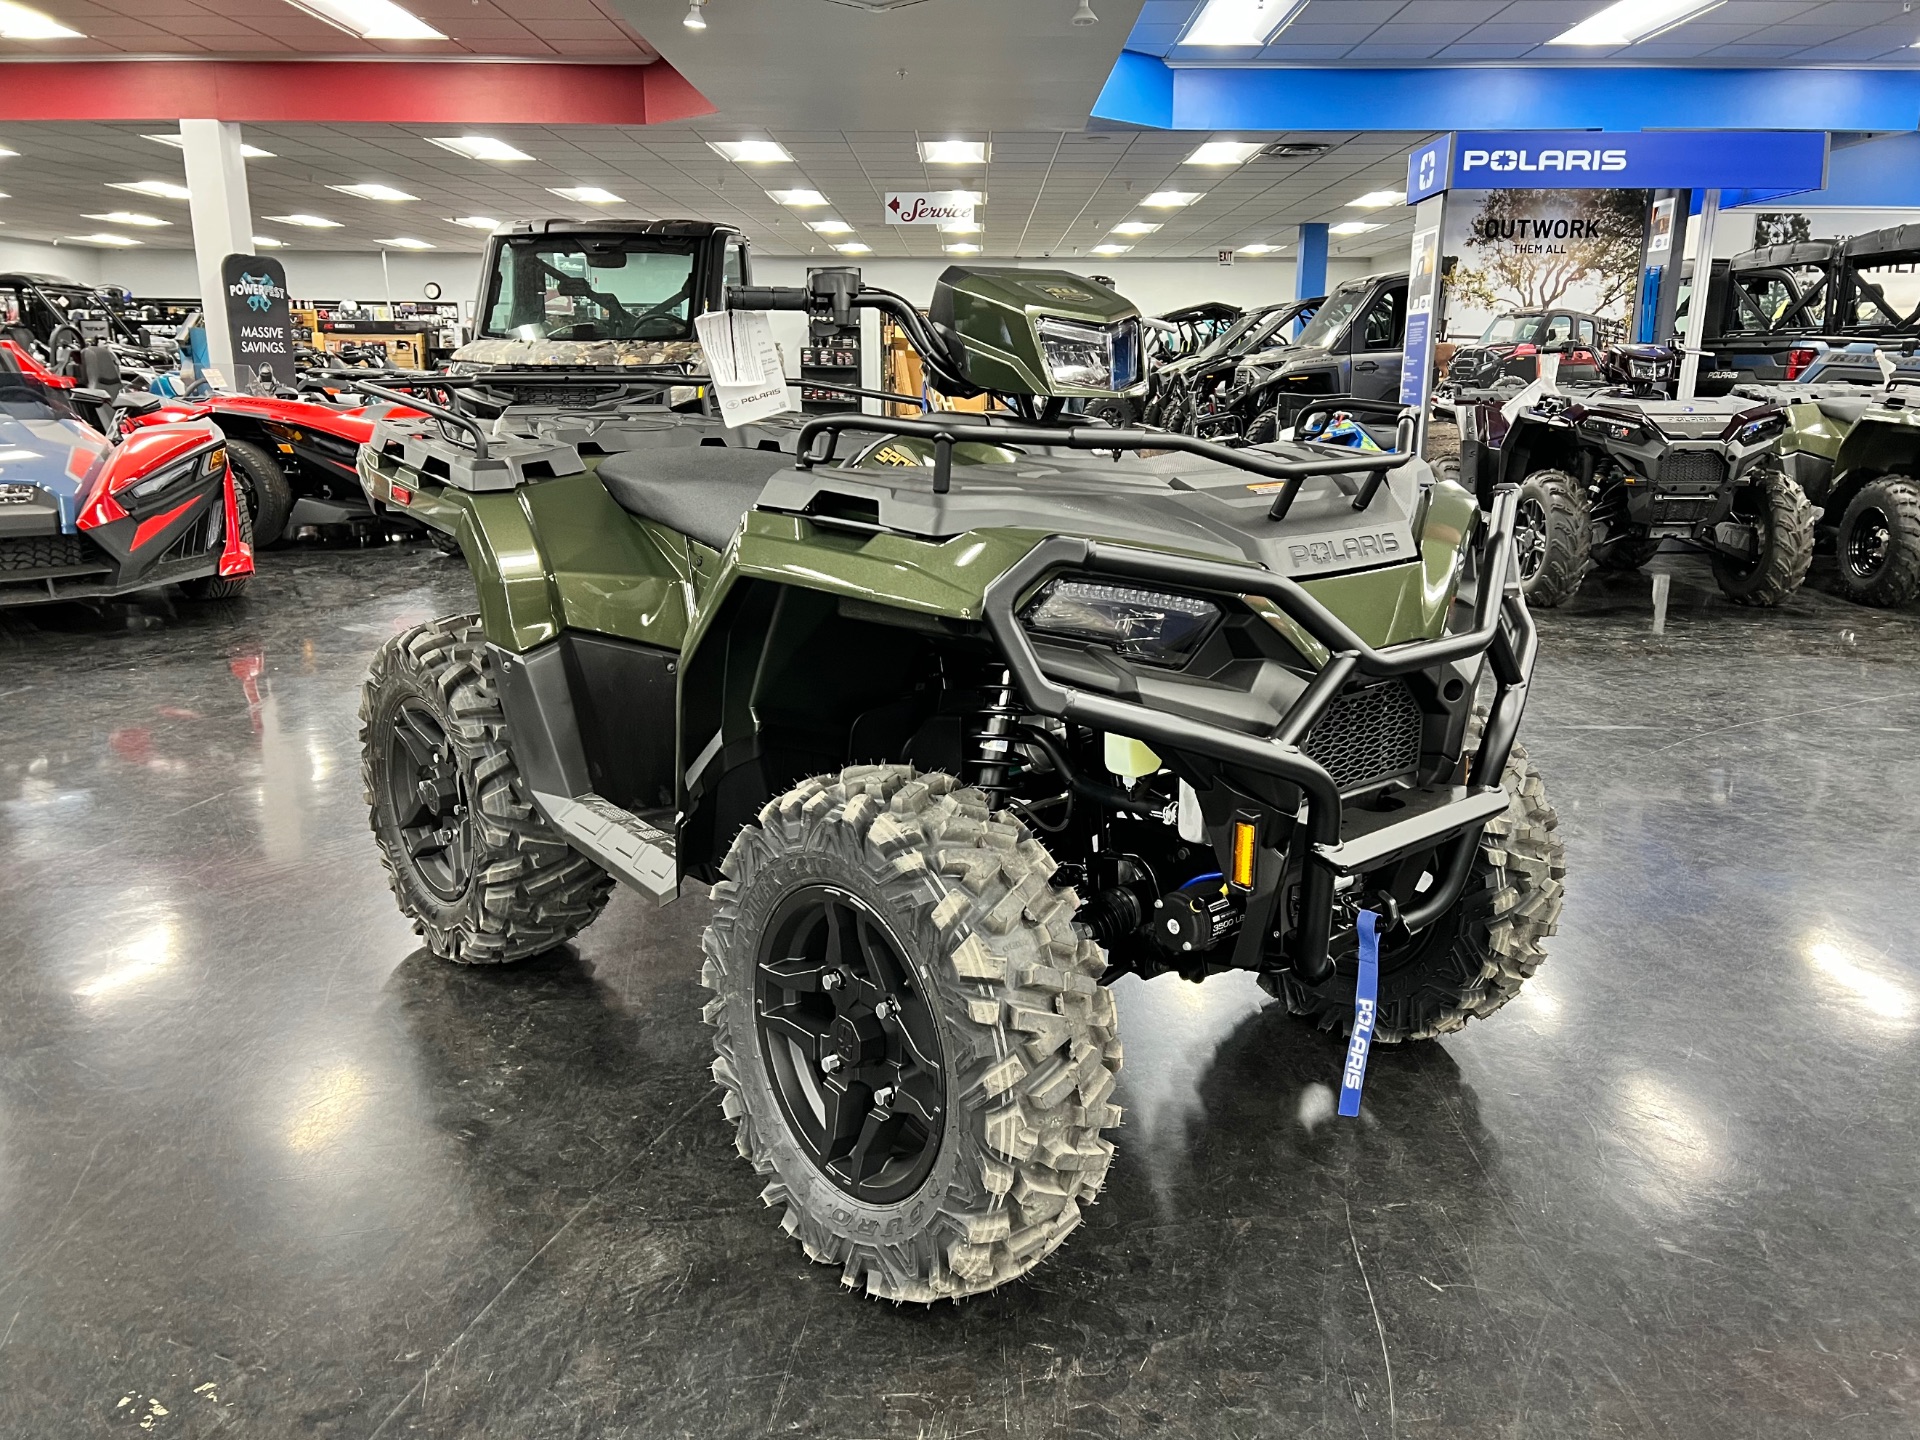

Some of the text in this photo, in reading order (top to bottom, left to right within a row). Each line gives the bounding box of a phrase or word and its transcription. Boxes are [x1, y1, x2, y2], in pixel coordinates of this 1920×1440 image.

[1463, 149, 1628, 171] POLARIS
[901, 197, 973, 222] Service
[1484, 219, 1600, 239] OUTWORK
[1219, 251, 1233, 261] EXIT
[1513, 244, 1567, 254] THEM ALL
[229, 283, 285, 299] POWERFEST
[240, 326, 284, 339] MASSIVE
[240, 341, 287, 354] SAVINGS.
[1707, 371, 1739, 379] POLARIS
[741, 388, 781, 405] POLARIS
[1288, 532, 1400, 568] POLARIS
[1212, 918, 1234, 932] 3500
[1345, 998, 1374, 1090] POLARIS
